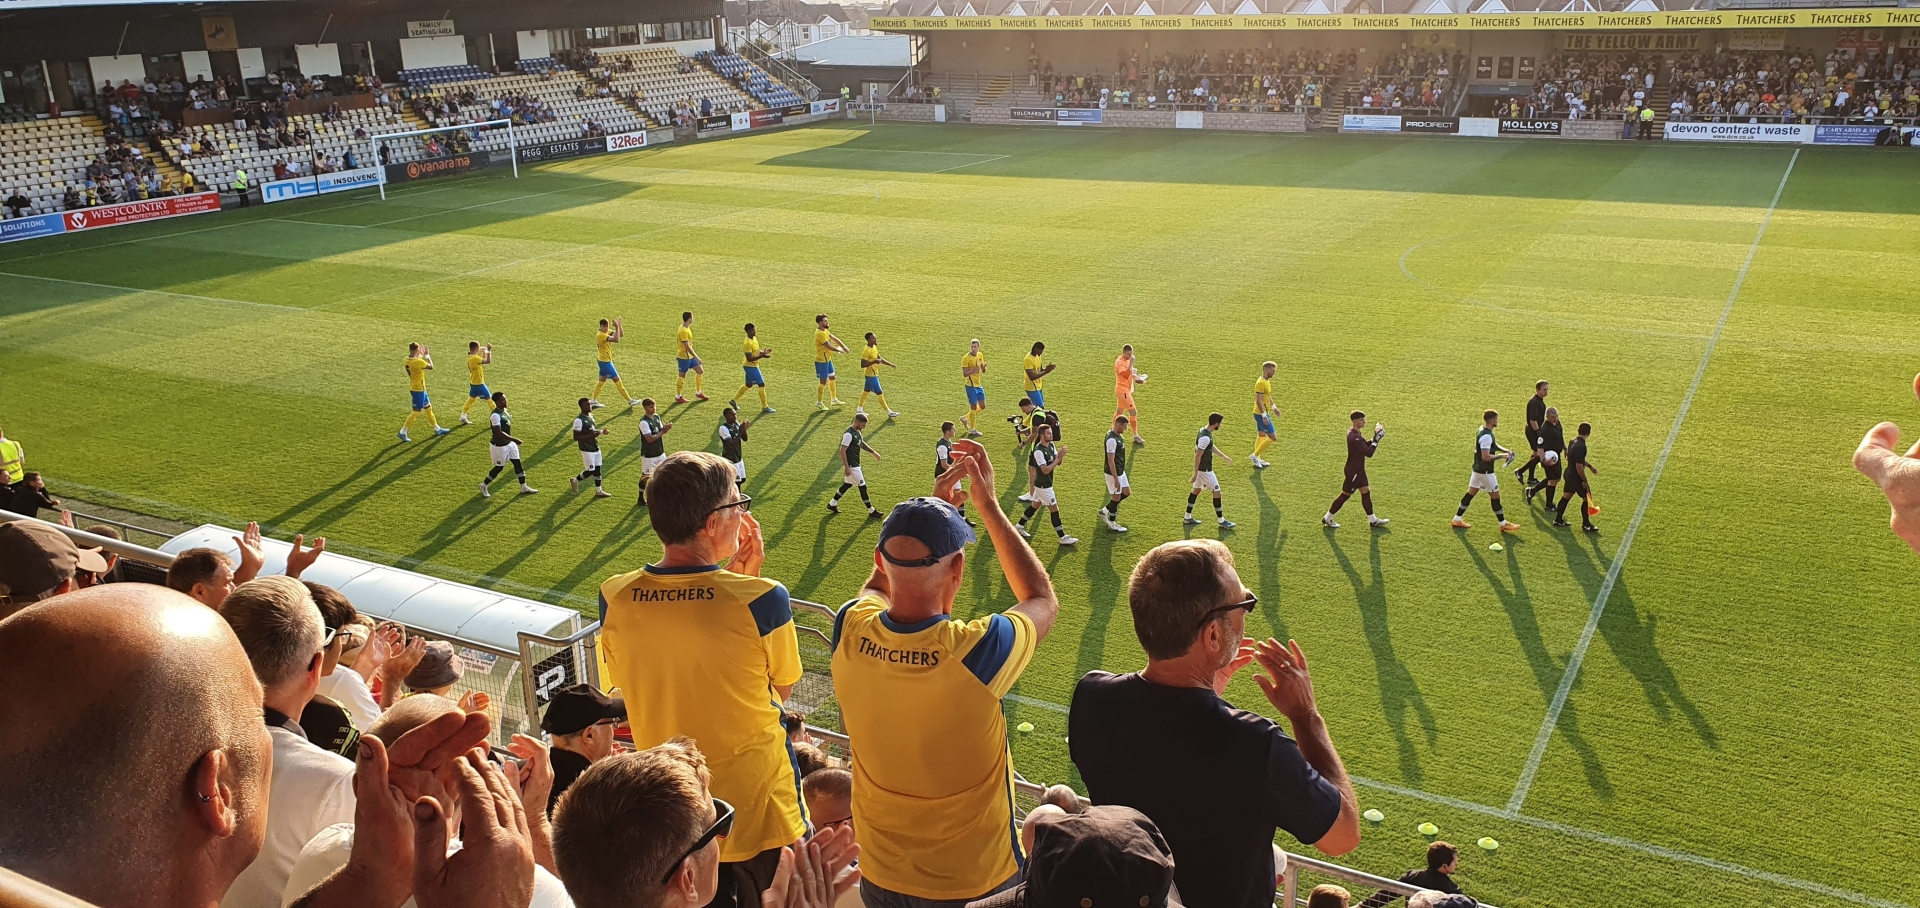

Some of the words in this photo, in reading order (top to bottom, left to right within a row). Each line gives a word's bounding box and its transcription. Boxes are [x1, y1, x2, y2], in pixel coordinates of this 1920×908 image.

[873, 20, 906, 28] THATCHERS
[913, 20, 947, 28] THATCHERS
[956, 20, 991, 28] THATCHERS
[1000, 19, 1036, 28] THATCHERS
[1046, 19, 1083, 28] THATCHERS
[1093, 18, 1131, 27] THATCHERS
[1141, 18, 1181, 27] THATCHERS
[1191, 18, 1232, 27] THATCHERS
[1243, 18, 1286, 27] THATCHERS
[1297, 18, 1342, 27] THATCHERS
[1353, 18, 1398, 27] THATCHERS
[1411, 18, 1458, 27] THATCHERS
[1470, 17, 1520, 26] THATCHERS
[1533, 17, 1584, 26] THATCHERS
[1598, 16, 1651, 26] THATCHERS
[1665, 14, 1722, 25] THATCHERS
[1737, 14, 1795, 24] THATCHERS
[1811, 14, 1871, 24] THATCHERS
[411, 28, 436, 36] SEATING
[1567, 34, 1592, 48] THE
[1596, 35, 1652, 48] YELLOW
[1654, 34, 1698, 48] ARMY
[1502, 121, 1558, 129] MOLLOY'S
[1672, 124, 1707, 133] devon
[1711, 126, 1761, 135] contract
[1764, 127, 1800, 135] waste
[610, 133, 644, 149] 32Red
[522, 148, 541, 157] PEGG
[550, 142, 579, 153] ESTATES
[419, 156, 470, 173] vanarama
[91, 200, 168, 219] WESTCOUNTRY
[129, 212, 159, 221] PROTECTION
[3, 220, 46, 232] SOLUTIONS
[632, 588, 714, 602] THATCHERS
[859, 636, 940, 666] THATCHERS
